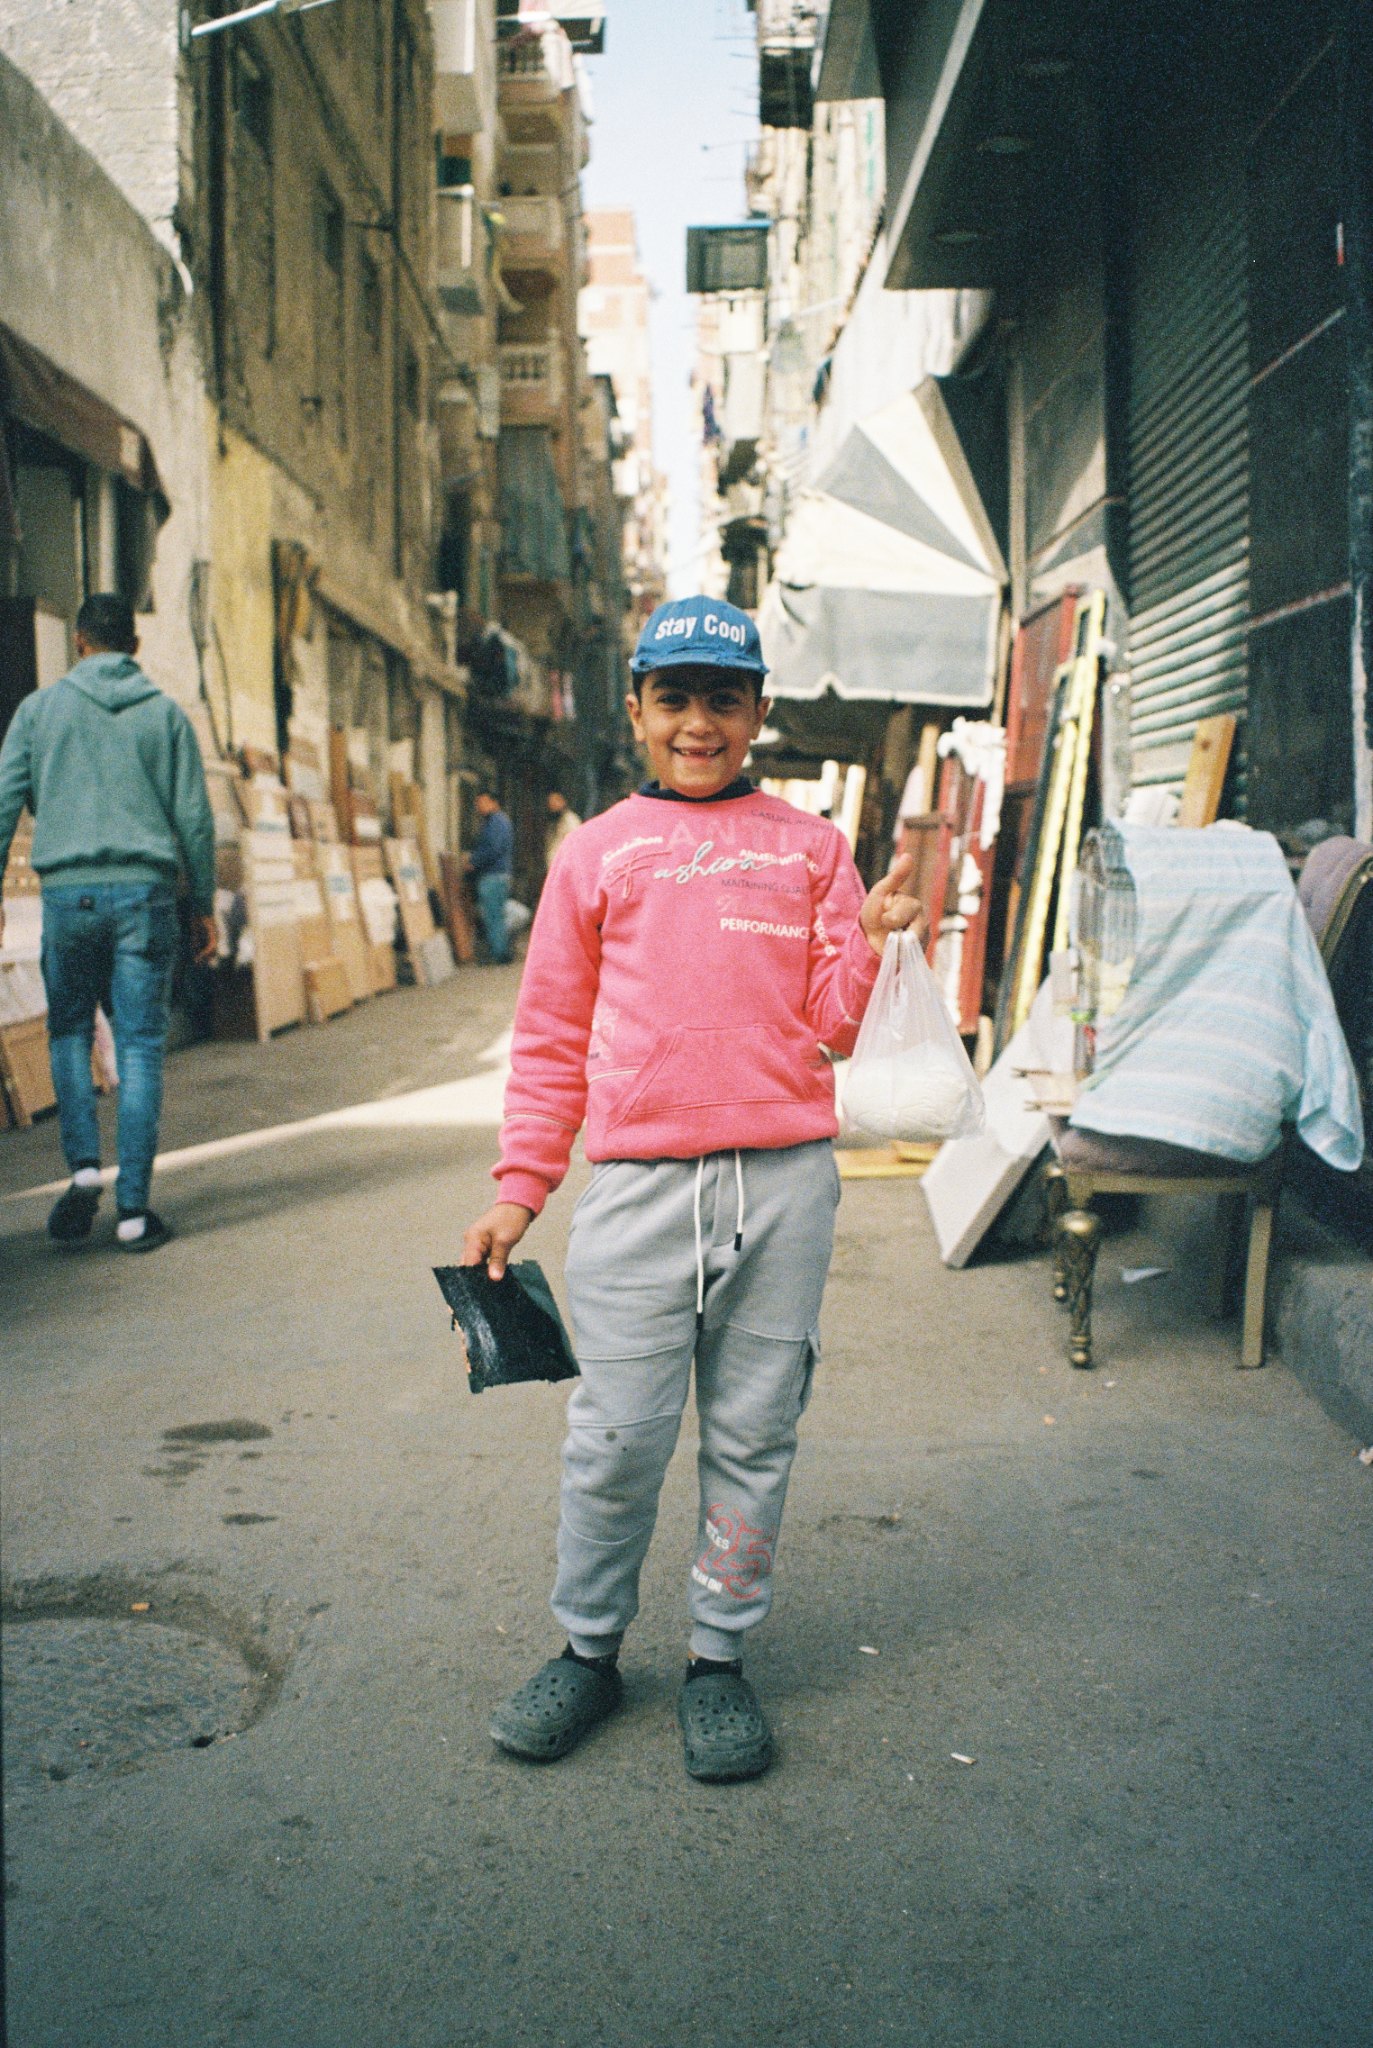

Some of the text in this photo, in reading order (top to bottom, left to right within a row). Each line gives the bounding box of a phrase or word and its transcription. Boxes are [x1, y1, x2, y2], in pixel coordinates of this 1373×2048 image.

[703, 613, 746, 647] Cool
[739, 848, 778, 862] ARMED
[605, 840, 779, 901] Fashion
[719, 917, 810, 940] PERFORMANC
